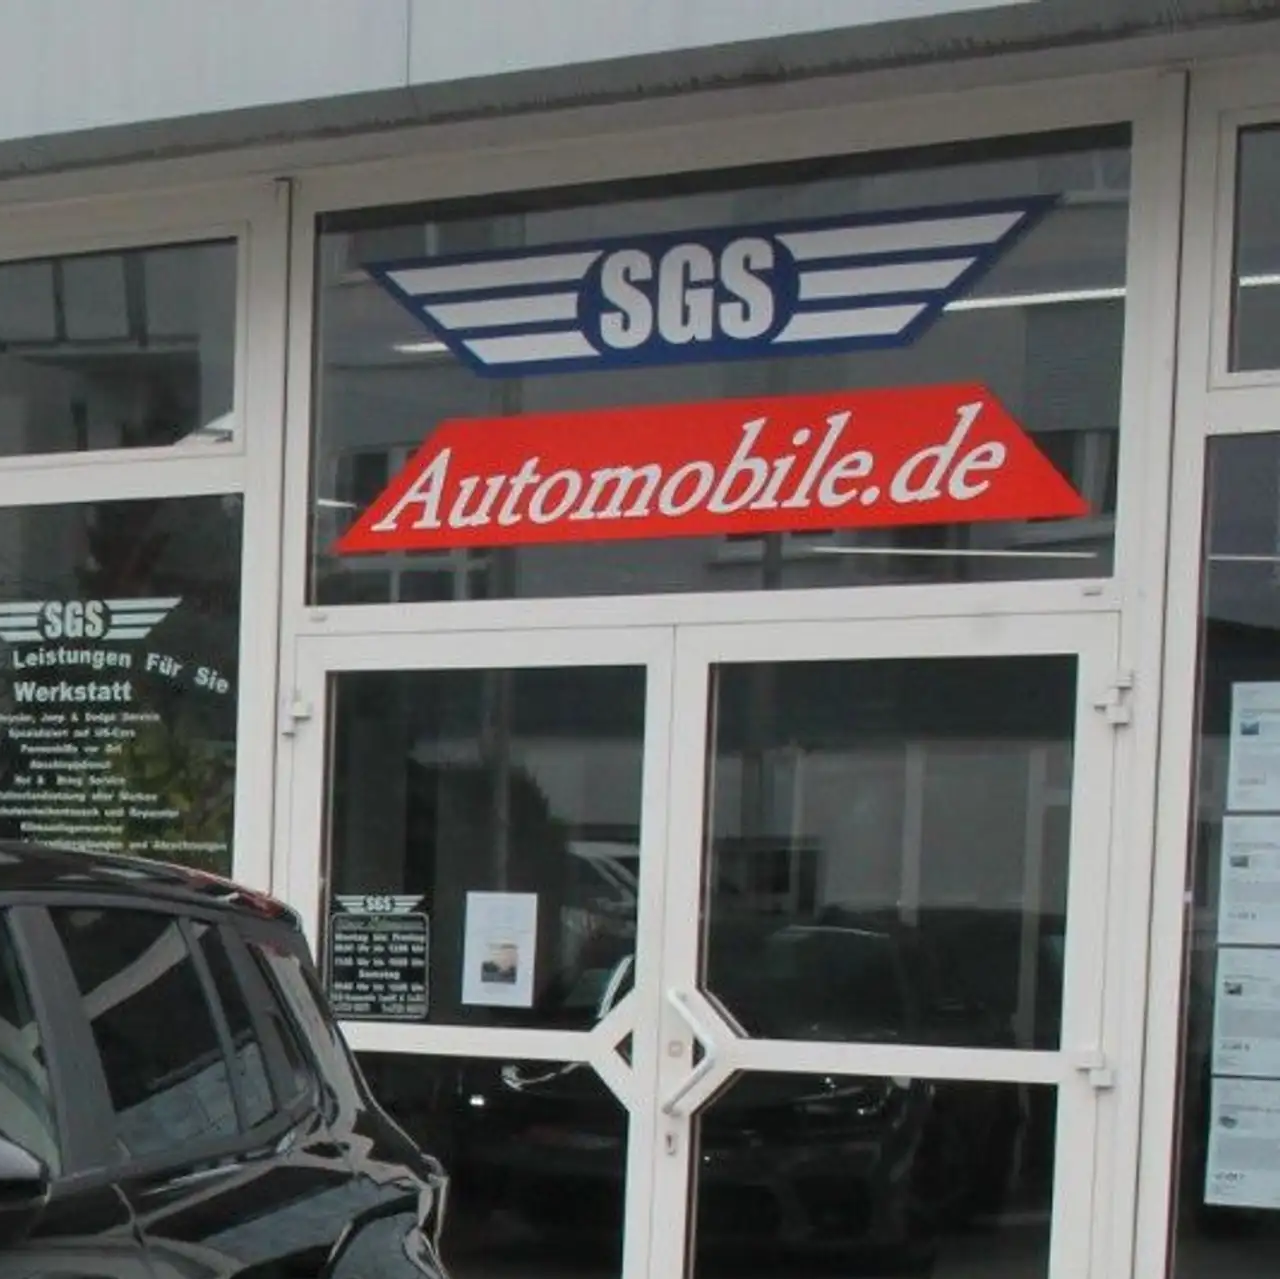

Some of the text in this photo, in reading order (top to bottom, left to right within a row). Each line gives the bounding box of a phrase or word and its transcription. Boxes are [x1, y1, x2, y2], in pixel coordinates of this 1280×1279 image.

[599, 236, 776, 350] SGS
[370, 401, 1009, 533] Automobile.de
[44, 600, 104, 639] SGS
[12, 650, 132, 670] Leistungen
[145, 652, 183, 679] Für
[193, 666, 230, 694] Sie
[13, 680, 133, 702] Werkstatt
